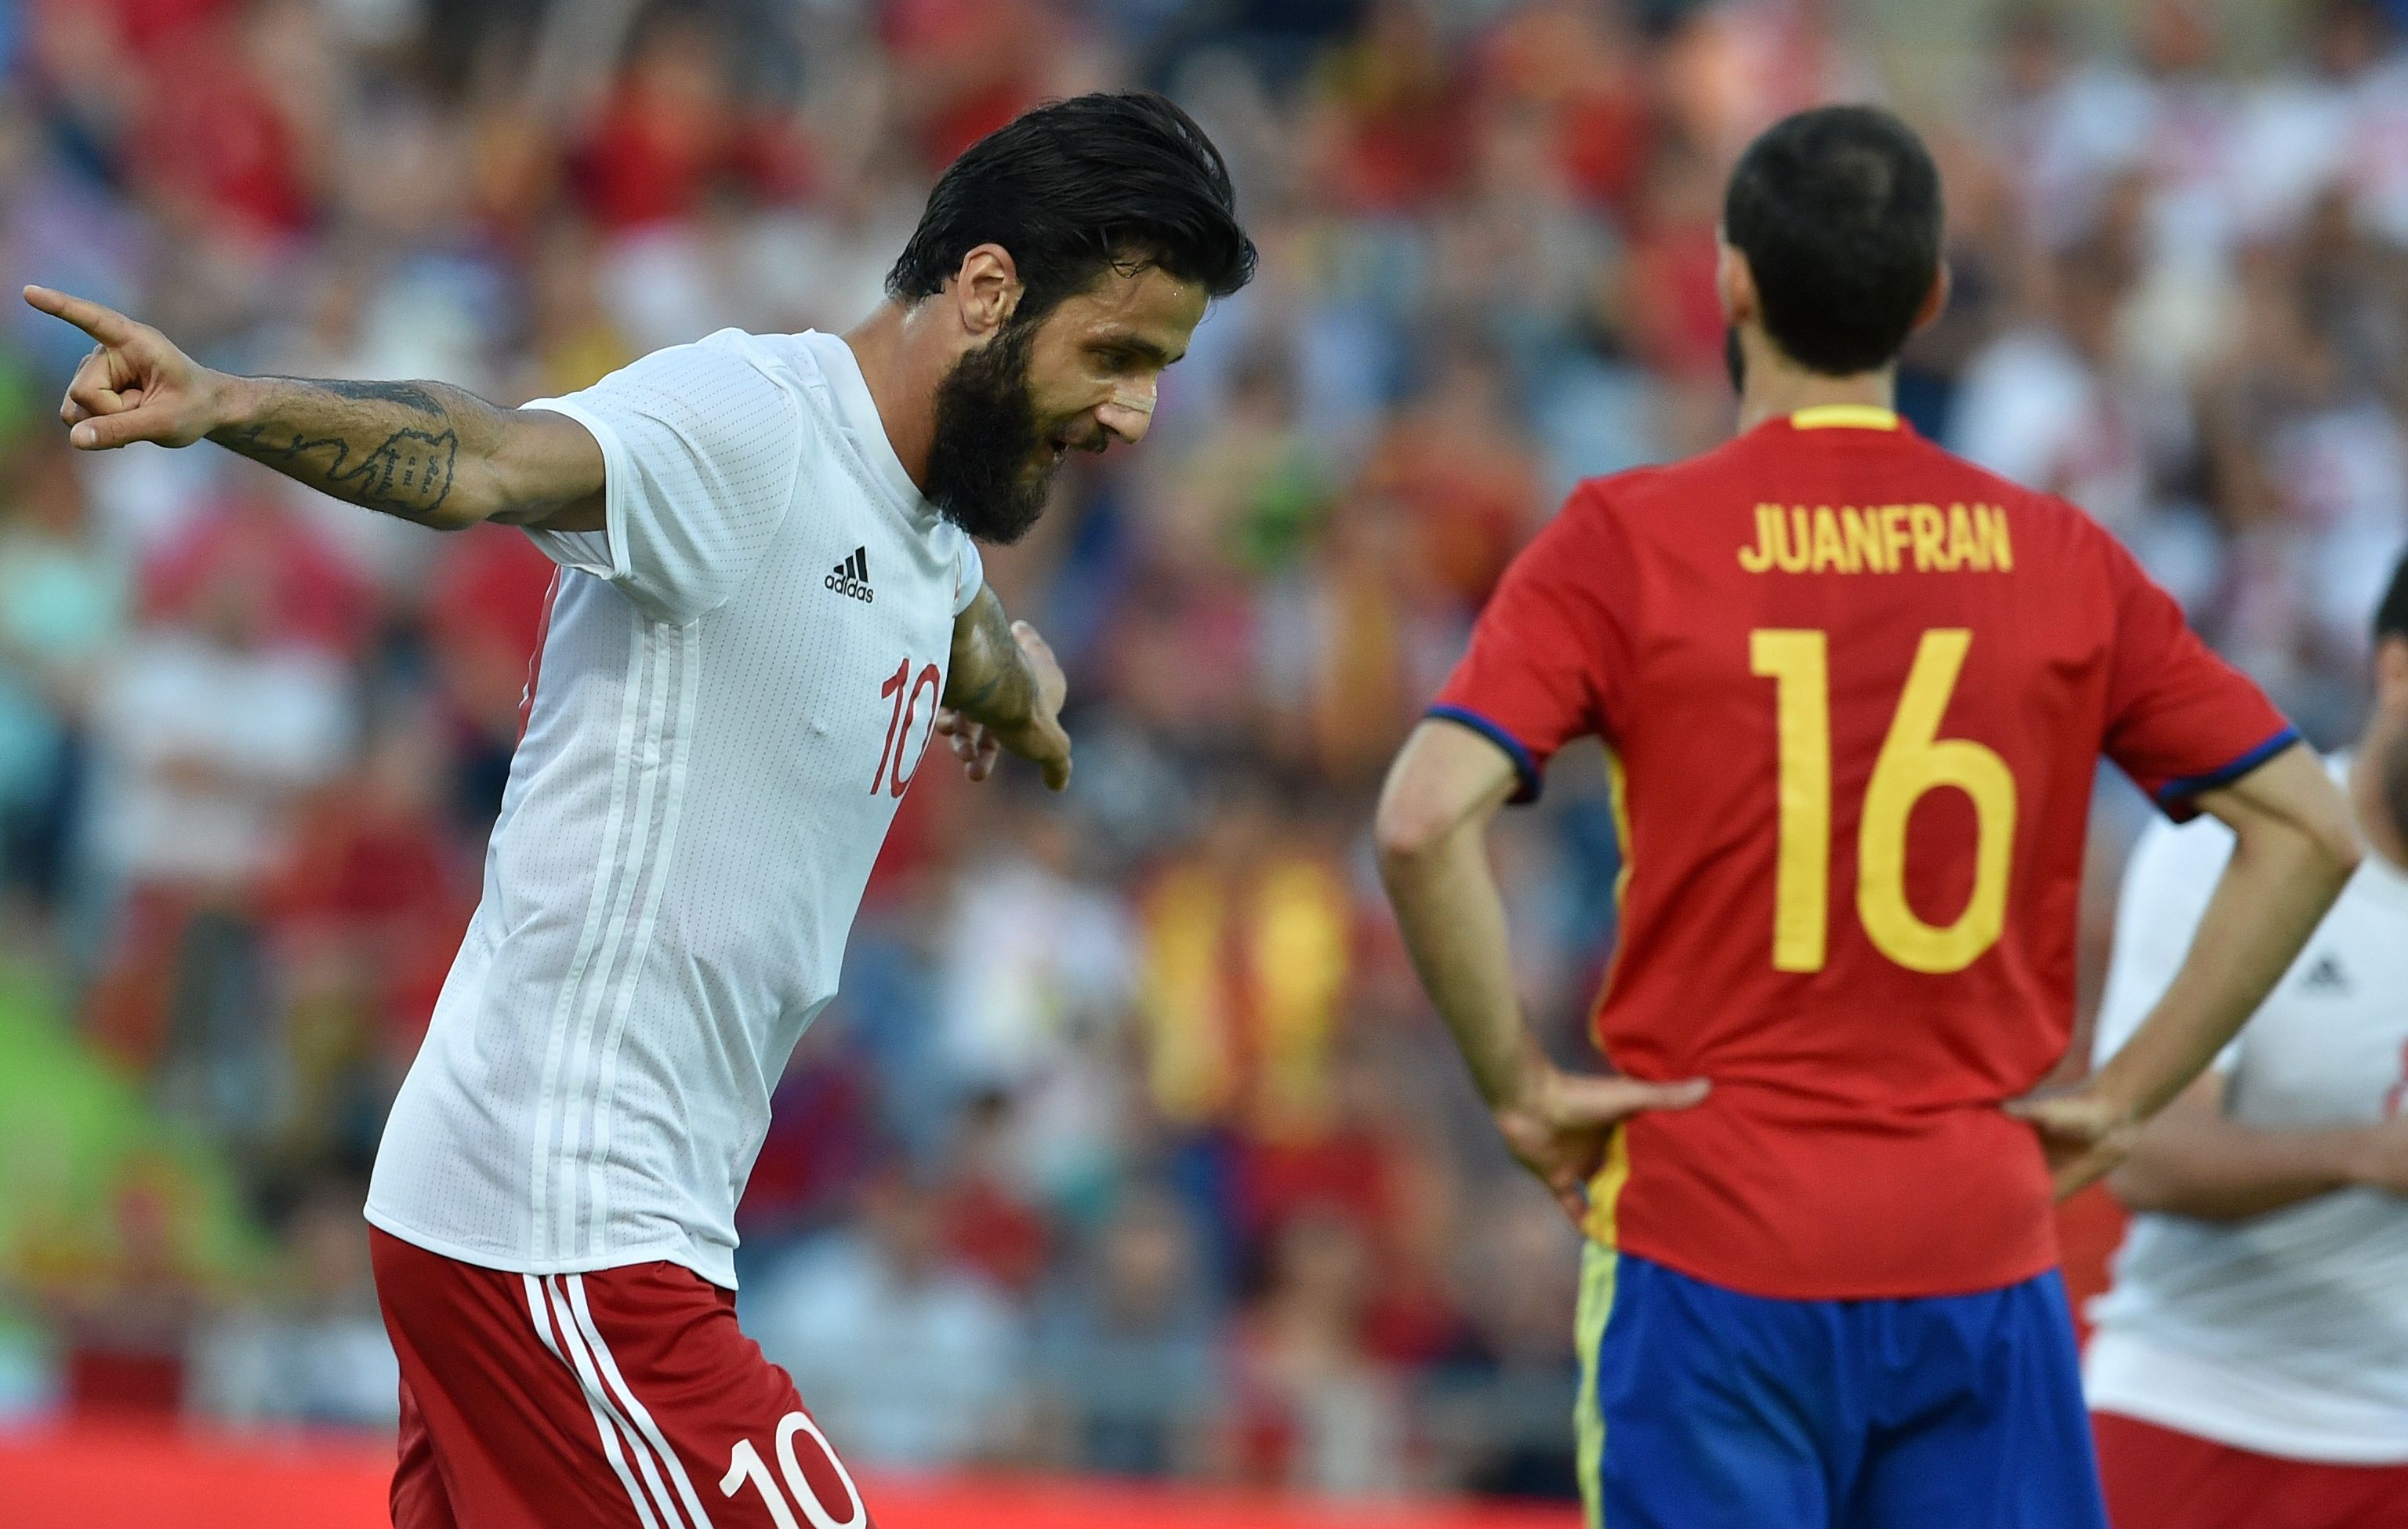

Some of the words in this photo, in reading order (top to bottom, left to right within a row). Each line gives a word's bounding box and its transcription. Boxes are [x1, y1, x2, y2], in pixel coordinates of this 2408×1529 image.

[824, 575, 874, 604] adidas
[1738, 503, 2013, 573] JUANFRAN
[870, 657, 941, 799] 10
[1749, 630, 2018, 974] 16
[719, 1411, 867, 1529] 10
